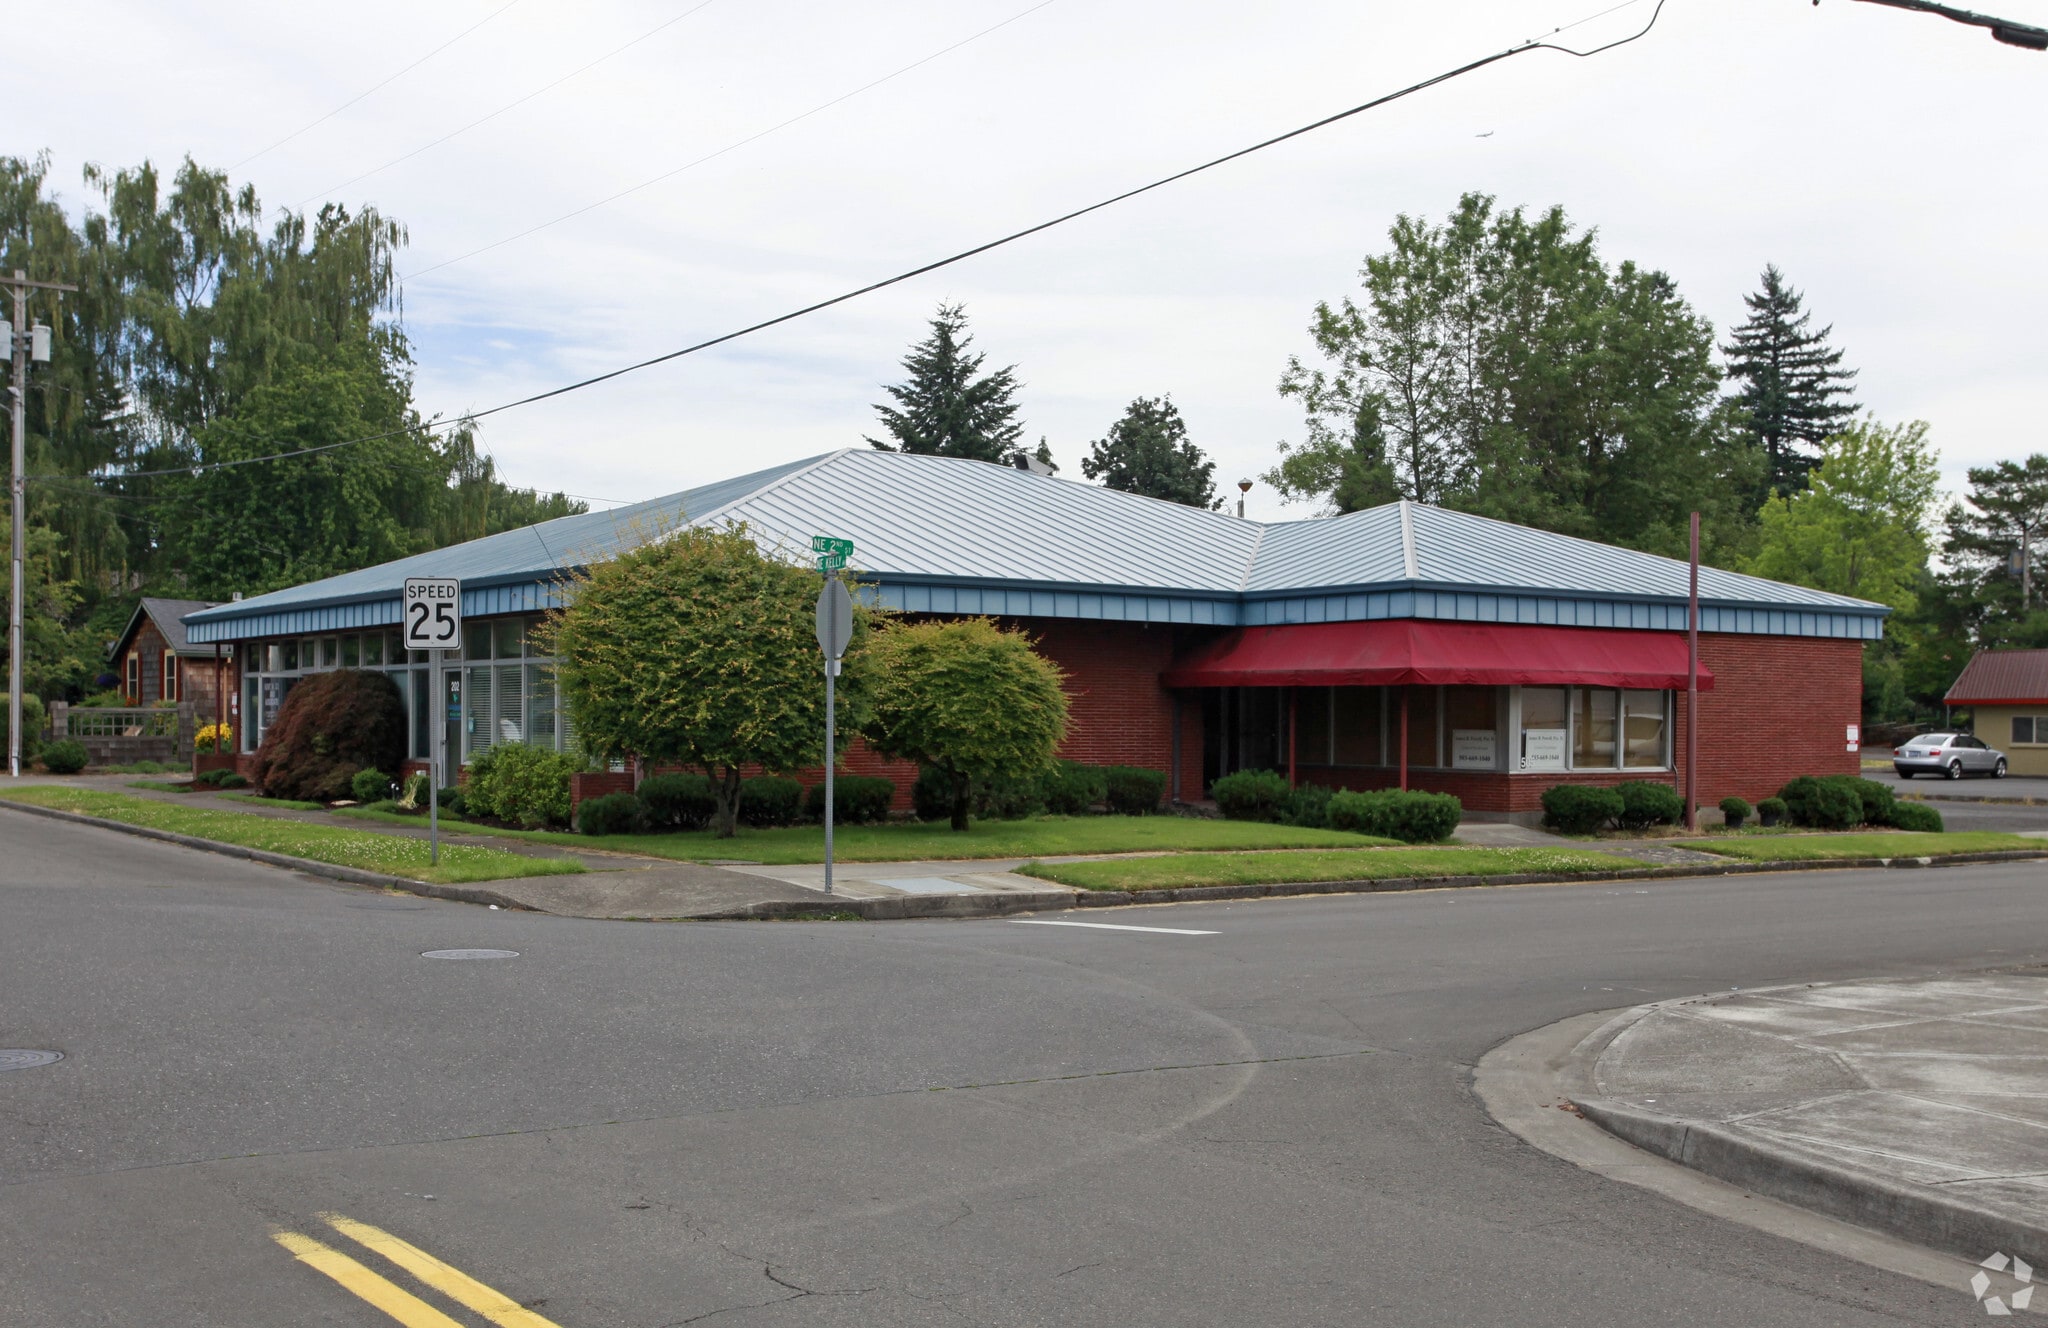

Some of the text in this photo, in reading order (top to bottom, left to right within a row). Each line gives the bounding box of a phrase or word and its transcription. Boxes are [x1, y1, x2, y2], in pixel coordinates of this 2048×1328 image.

[813, 538, 826, 551] NE
[816, 557, 824, 570] NE
[825, 555, 842, 569] KELLY
[408, 585, 456, 599] SPEED
[409, 602, 456, 641] 25
